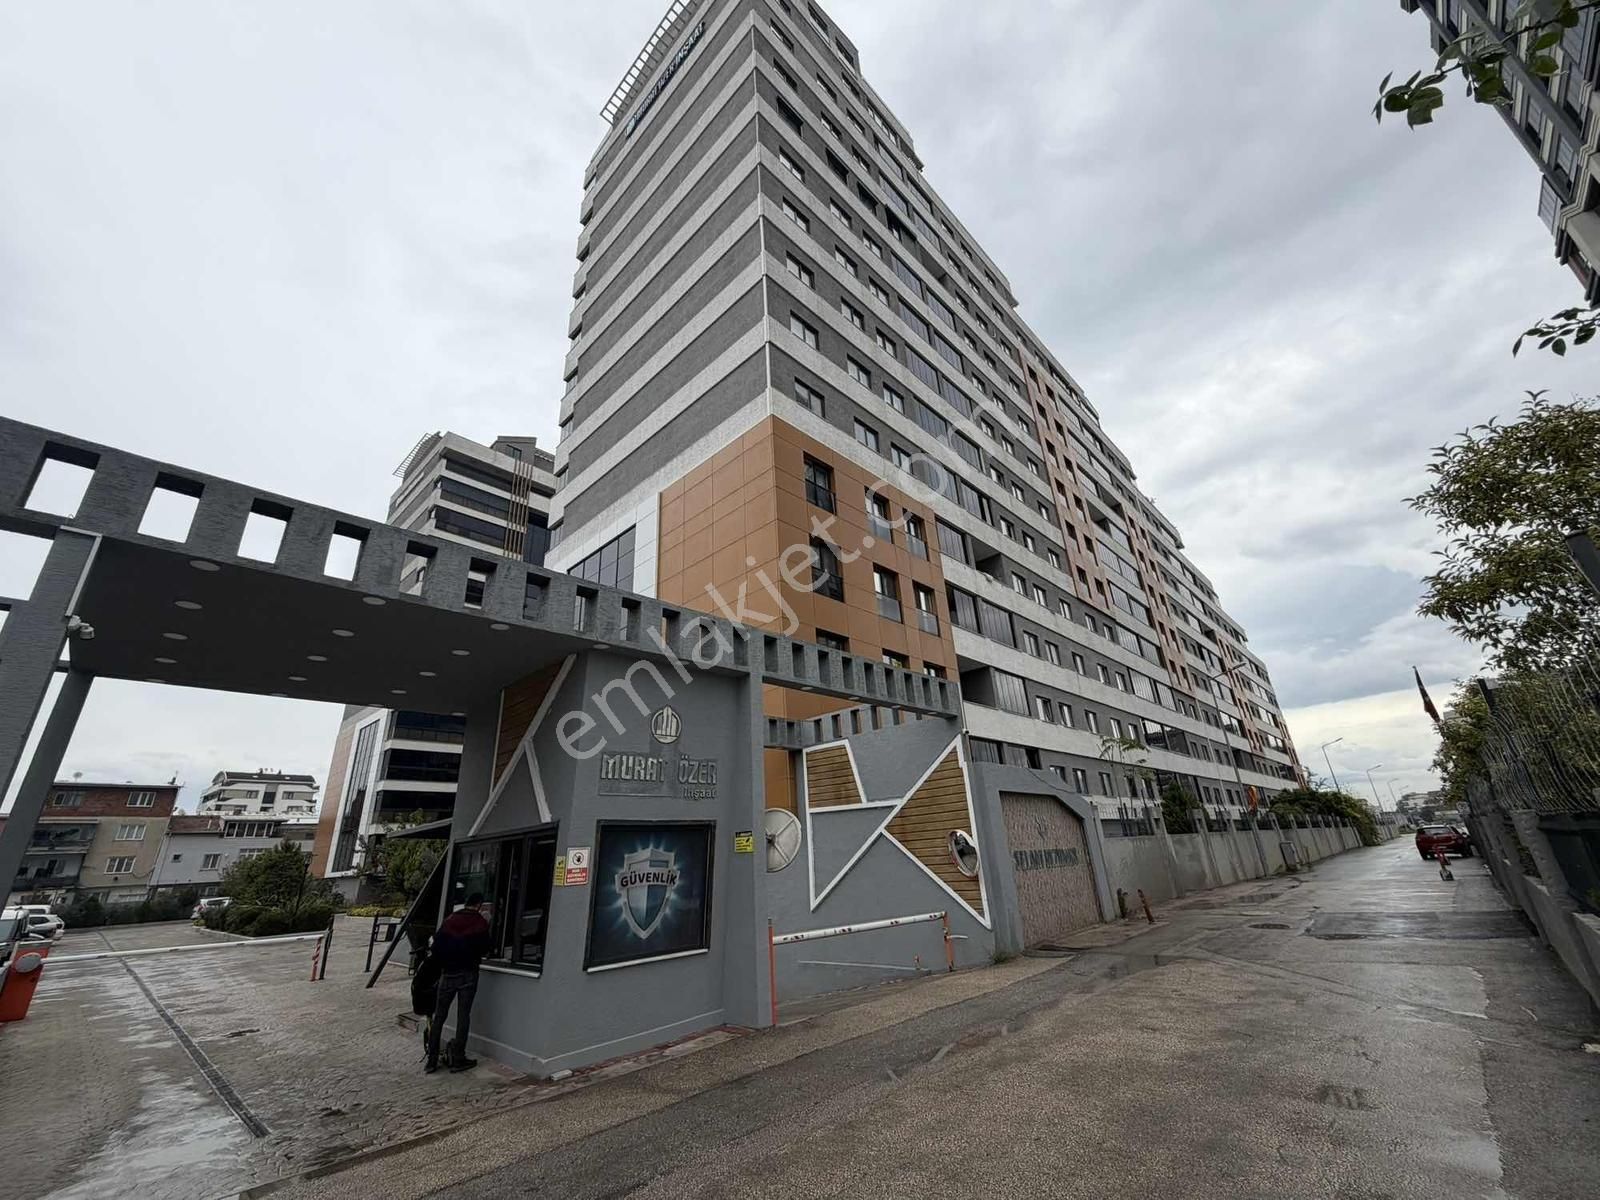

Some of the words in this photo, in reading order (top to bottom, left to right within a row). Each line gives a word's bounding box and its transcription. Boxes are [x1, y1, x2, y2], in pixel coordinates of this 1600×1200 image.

[601, 754, 666, 782] MURAT
[679, 755, 717, 784] ÖZER
[620, 870, 677, 887] GÜVENLİK
